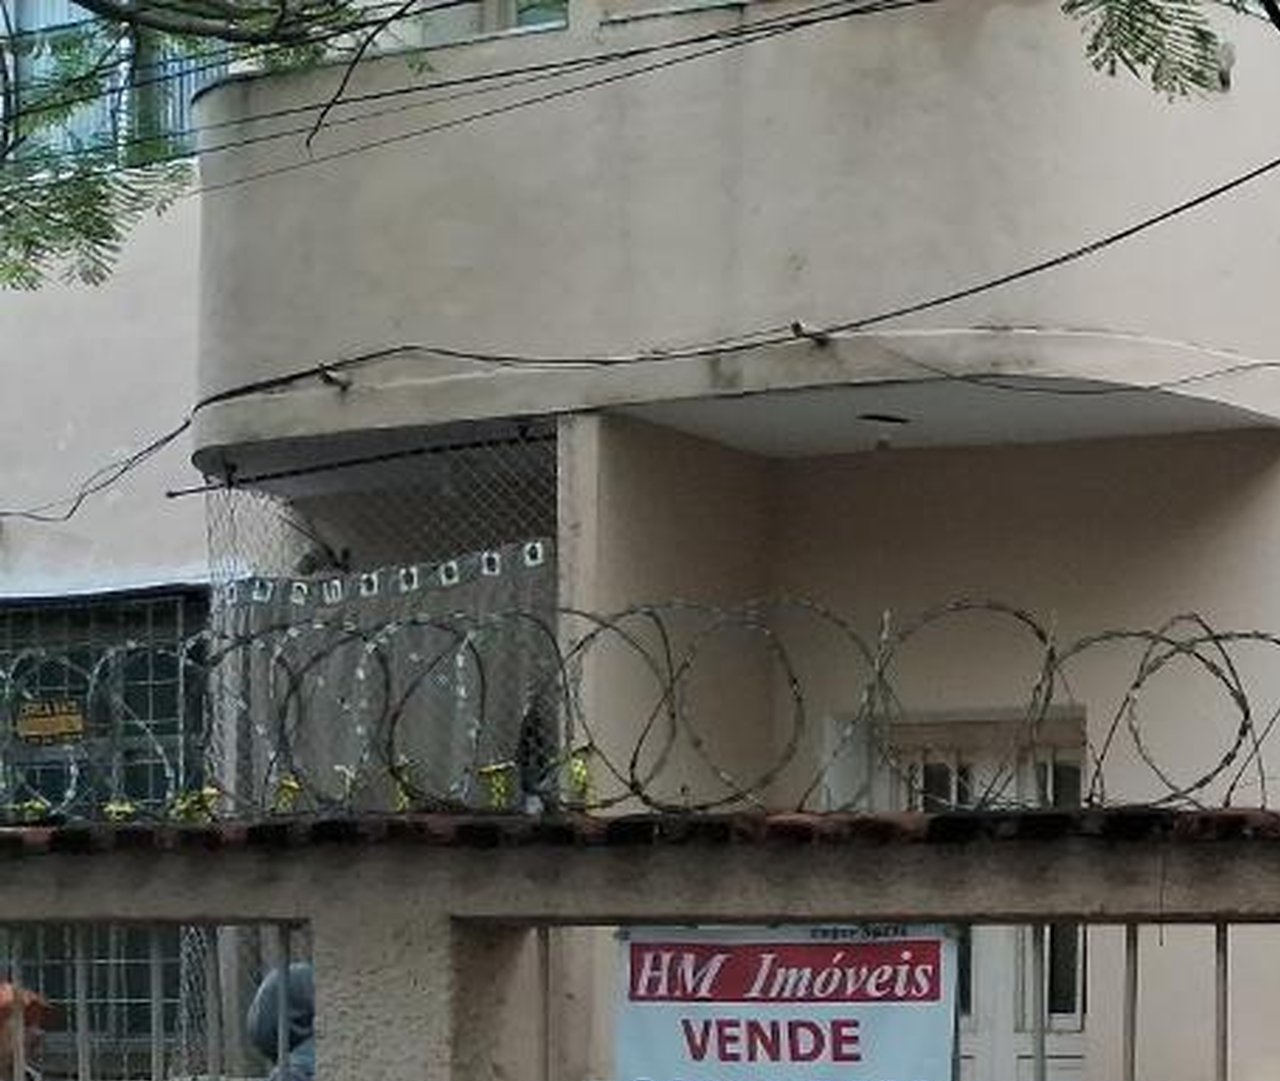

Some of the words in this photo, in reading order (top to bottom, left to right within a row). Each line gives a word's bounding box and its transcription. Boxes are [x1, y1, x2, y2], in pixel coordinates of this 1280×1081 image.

[634, 951, 732, 998] HM
[743, 951, 933, 998] Imóveis
[682, 1018, 862, 1063] VENDE
